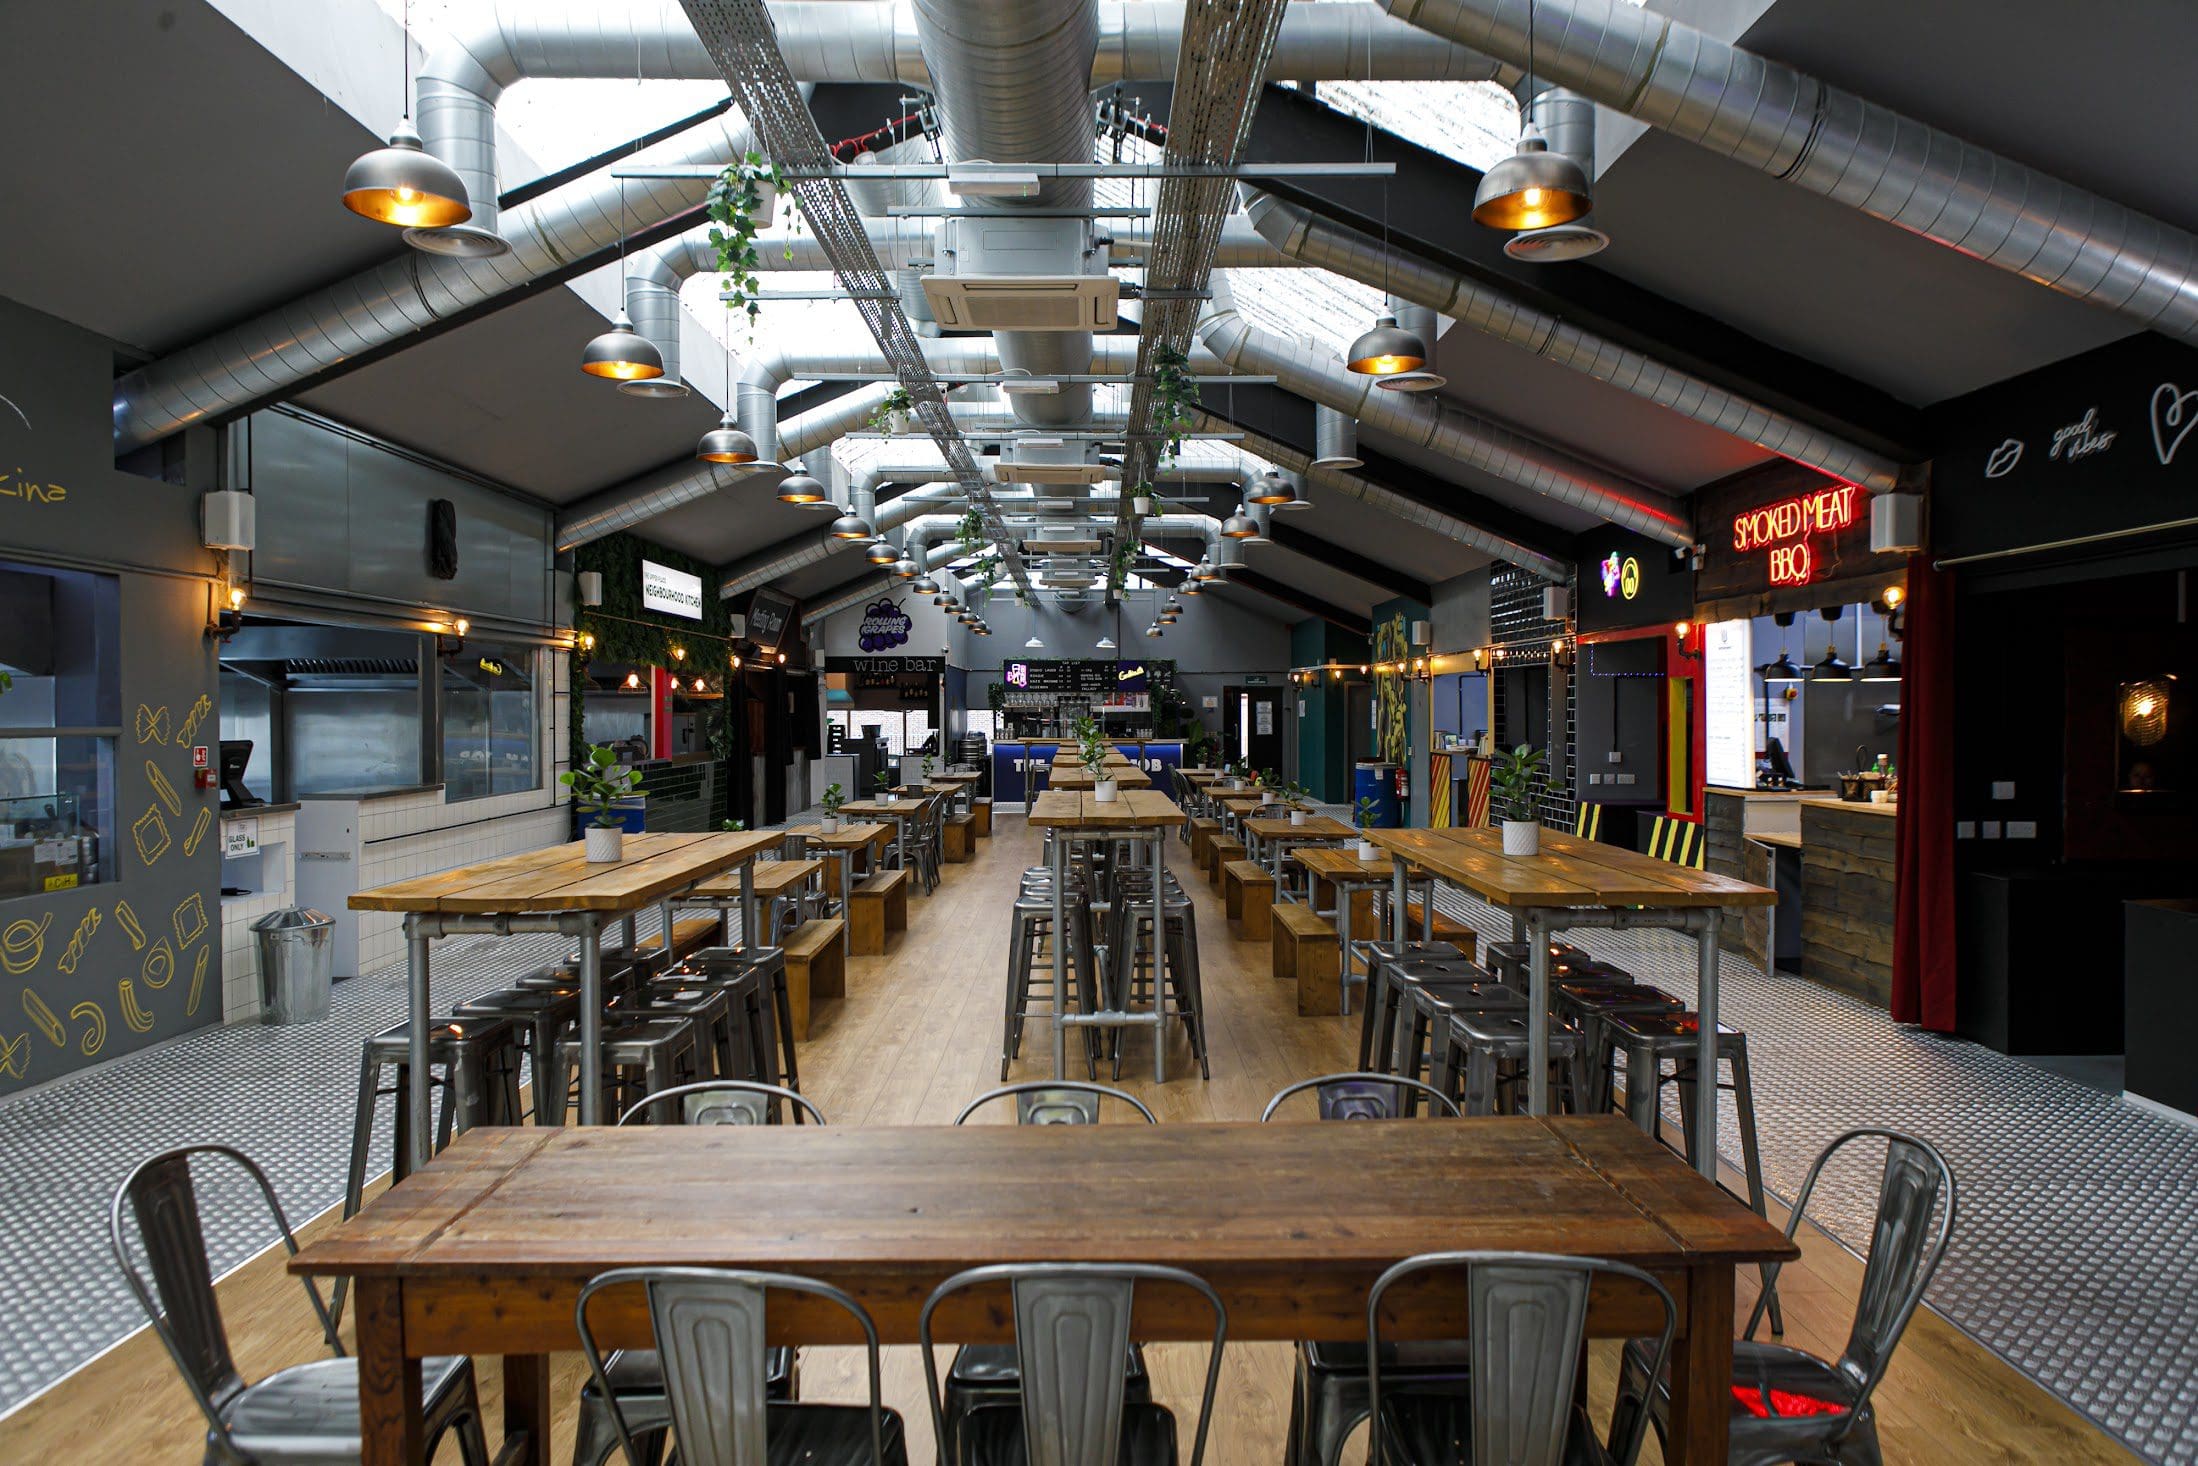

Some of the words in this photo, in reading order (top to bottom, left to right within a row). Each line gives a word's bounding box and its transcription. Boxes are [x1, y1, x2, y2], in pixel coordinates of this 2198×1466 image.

[2050, 408, 2096, 457] good
[2068, 425, 2117, 458] vibes
[1735, 502, 1801, 549] SMOKED
[1803, 486, 1853, 532] MEAT
[1770, 543, 1808, 582] BBQ
[863, 616, 907, 626] ROLLING
[861, 625, 906, 634] GRAPES
[854, 657, 899, 673] wine
[904, 657, 937, 673] bar
[228, 834, 246, 843] GLASS
[231, 843, 244, 851] ONLY
